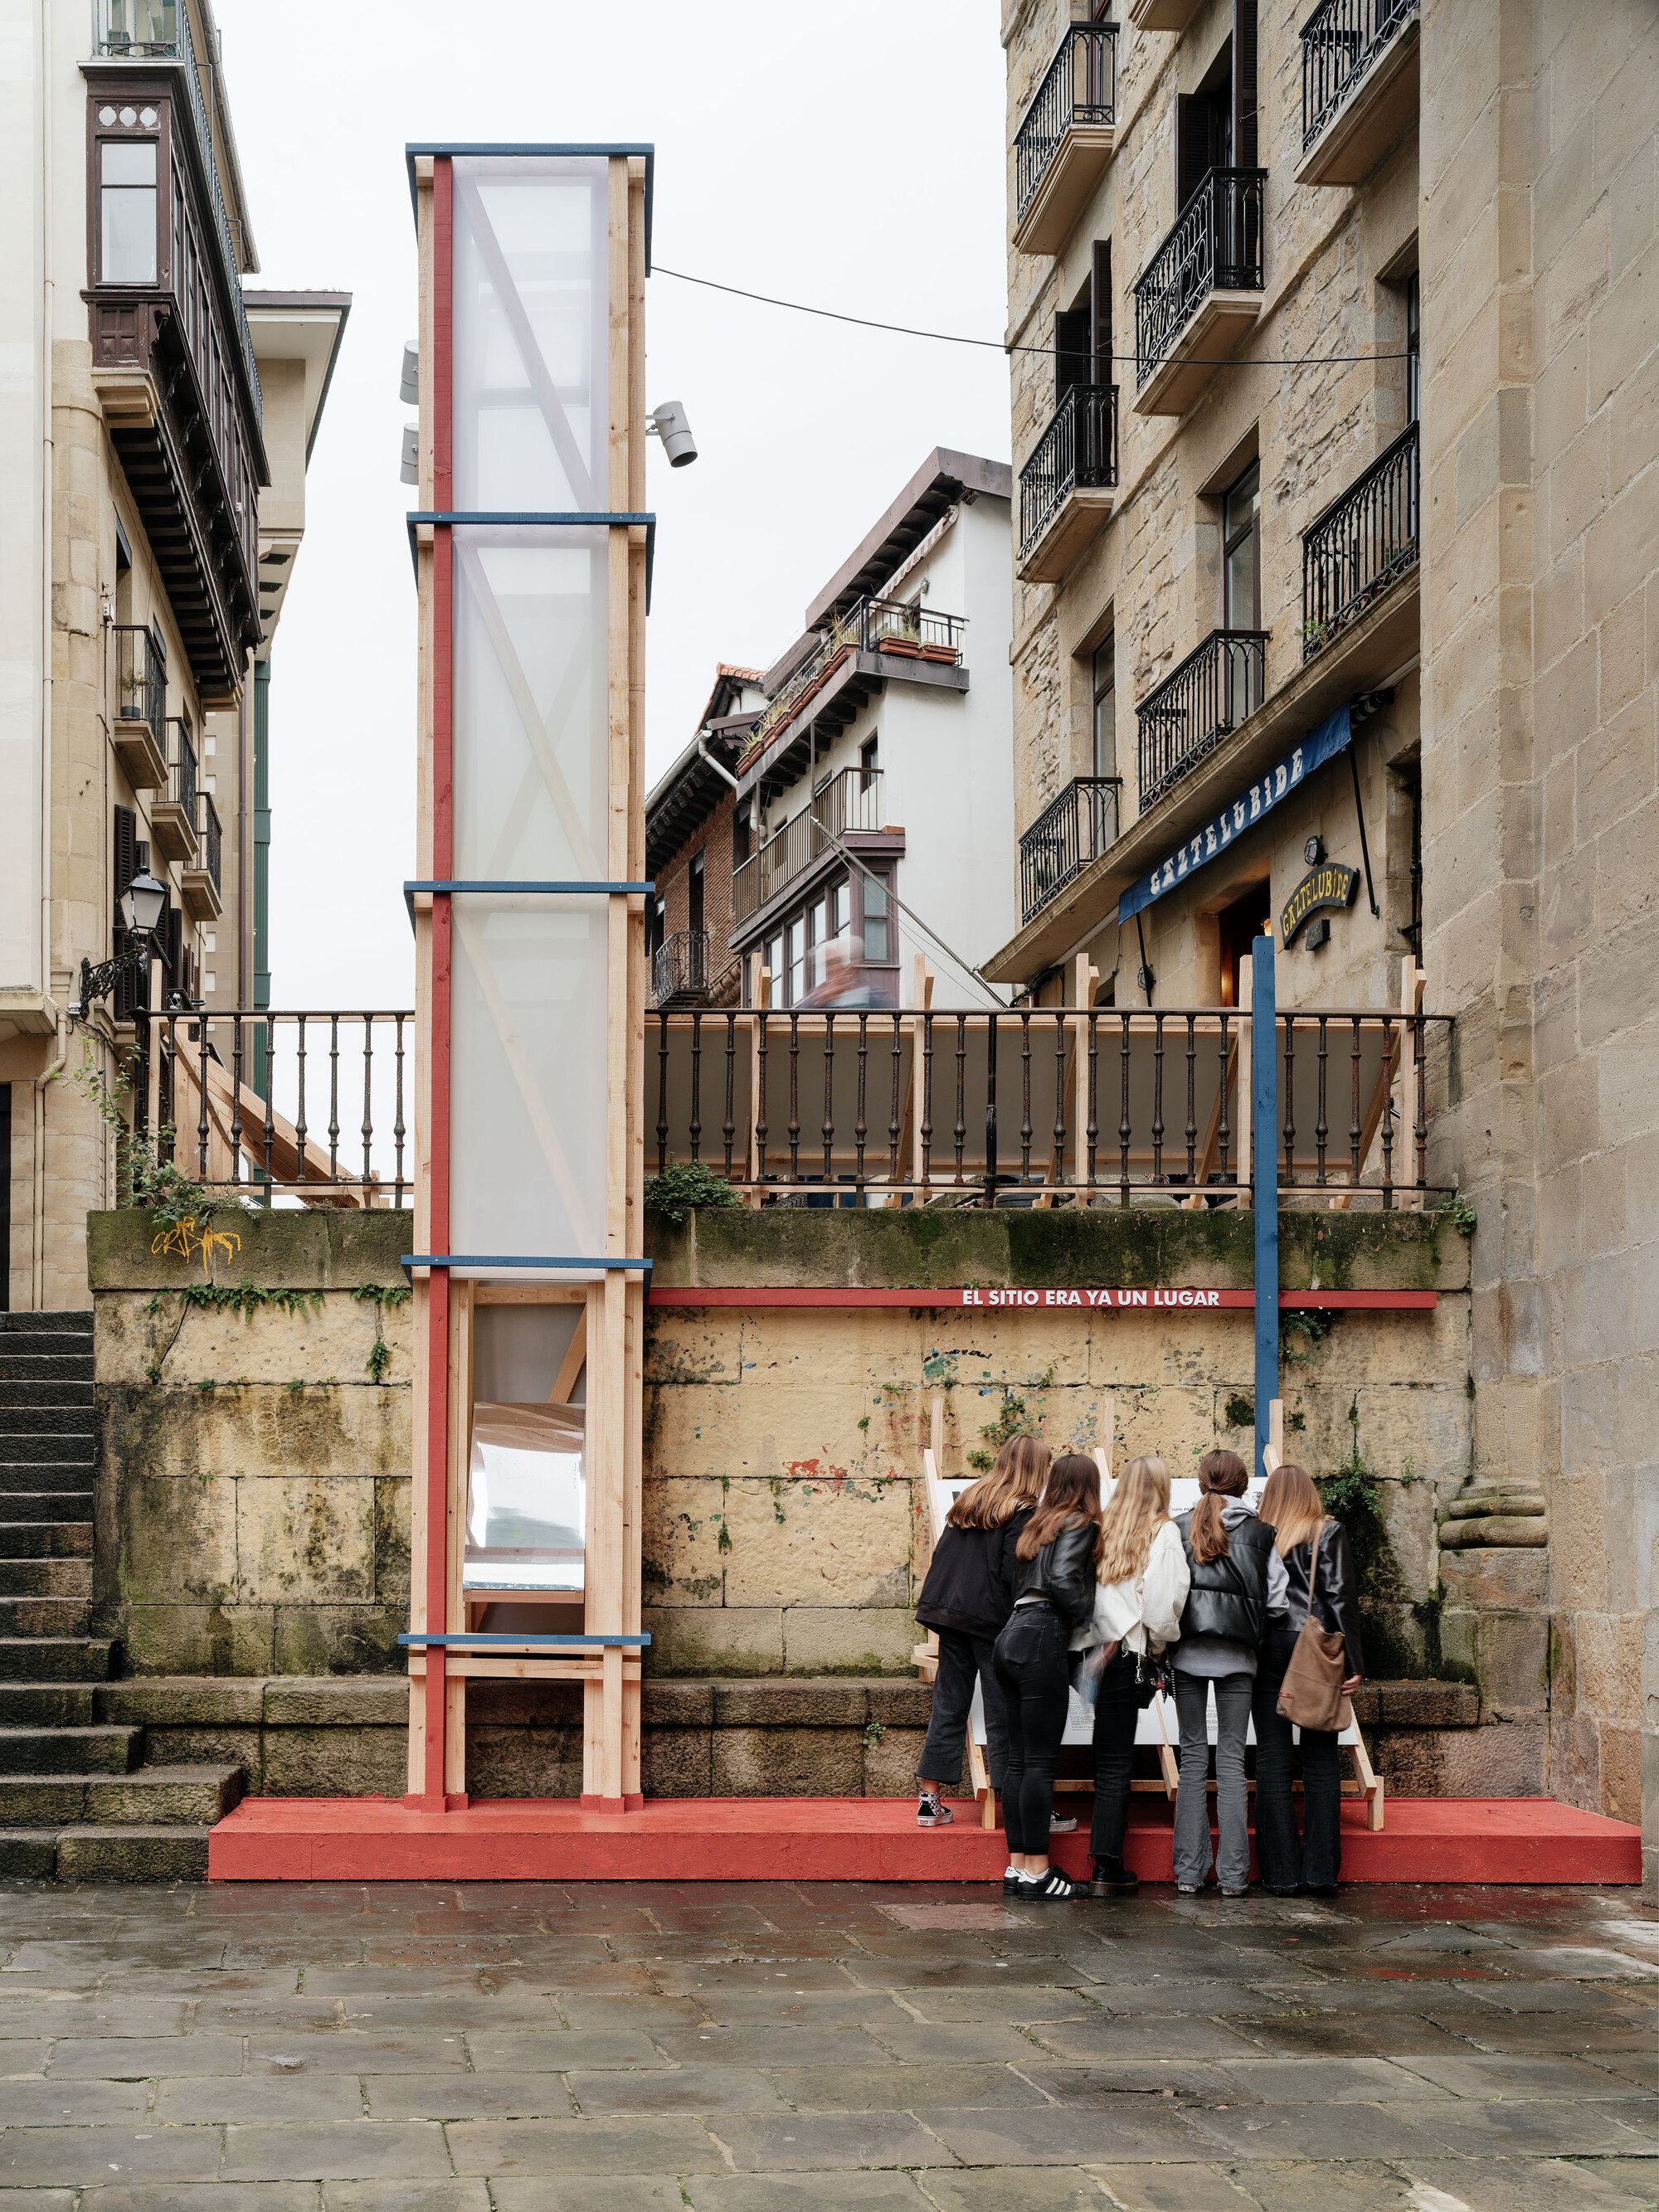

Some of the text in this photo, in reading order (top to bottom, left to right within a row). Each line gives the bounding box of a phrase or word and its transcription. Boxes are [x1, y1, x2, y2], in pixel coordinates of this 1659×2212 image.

[962, 1289, 1220, 1306] EL SITIO ERA YA UN LUGAR
